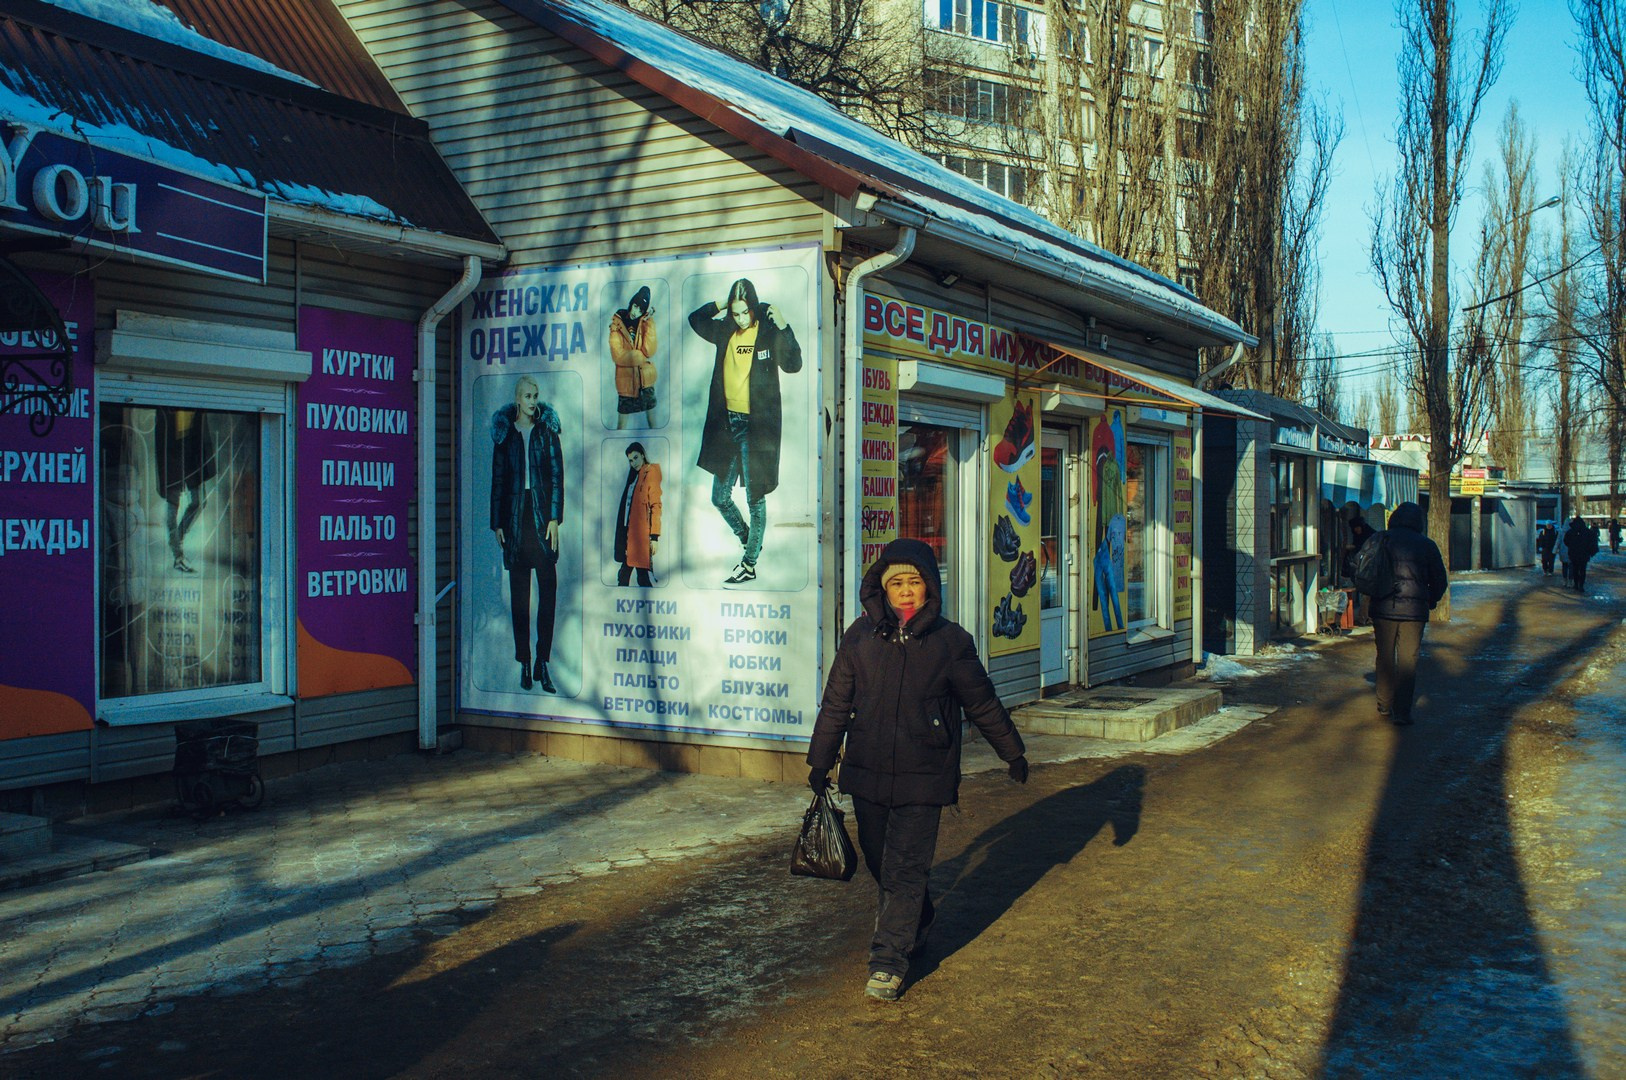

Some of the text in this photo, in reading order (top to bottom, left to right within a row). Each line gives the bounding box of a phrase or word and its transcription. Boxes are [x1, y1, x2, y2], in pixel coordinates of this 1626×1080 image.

[471, 282, 589, 320] ЖЕНСКАЯ
[470, 321, 588, 365] ОДЕЖДА
[864, 294, 924, 342] ВСЕ
[928, 312, 985, 355] ДЛЯ
[989, 327, 1080, 378] МУЖЧИН
[322, 348, 395, 381] КУРТКИ
[306, 402, 408, 435] ПУХОВИКИ
[862, 401, 895, 428] ДЕЖДА
[0, 447, 87, 484] РХНЕЙ
[321, 459, 395, 491] ПЛАЩИ
[862, 475, 895, 497] БАШКИ
[0, 518, 89, 556] ЕЖДЫ
[319, 514, 396, 541] ПАЛЬТО
[307, 568, 408, 598] ВЕТРОВКИ
[616, 598, 678, 615] КУРТКИ
[720, 602, 792, 620] ПЛАТЬЯ
[603, 622, 691, 641] ПУХОВИКИ
[723, 628, 788, 646] БРЮКИ
[616, 647, 677, 668] ПЛАЩИ
[728, 654, 782, 672] ЮБКИ
[613, 672, 680, 691] ПАЛЬТО
[721, 679, 789, 698] БЛУЗКИ
[603, 696, 689, 717] ВЕТРОВКИ
[708, 703, 803, 725] КОСТЮМЫ
